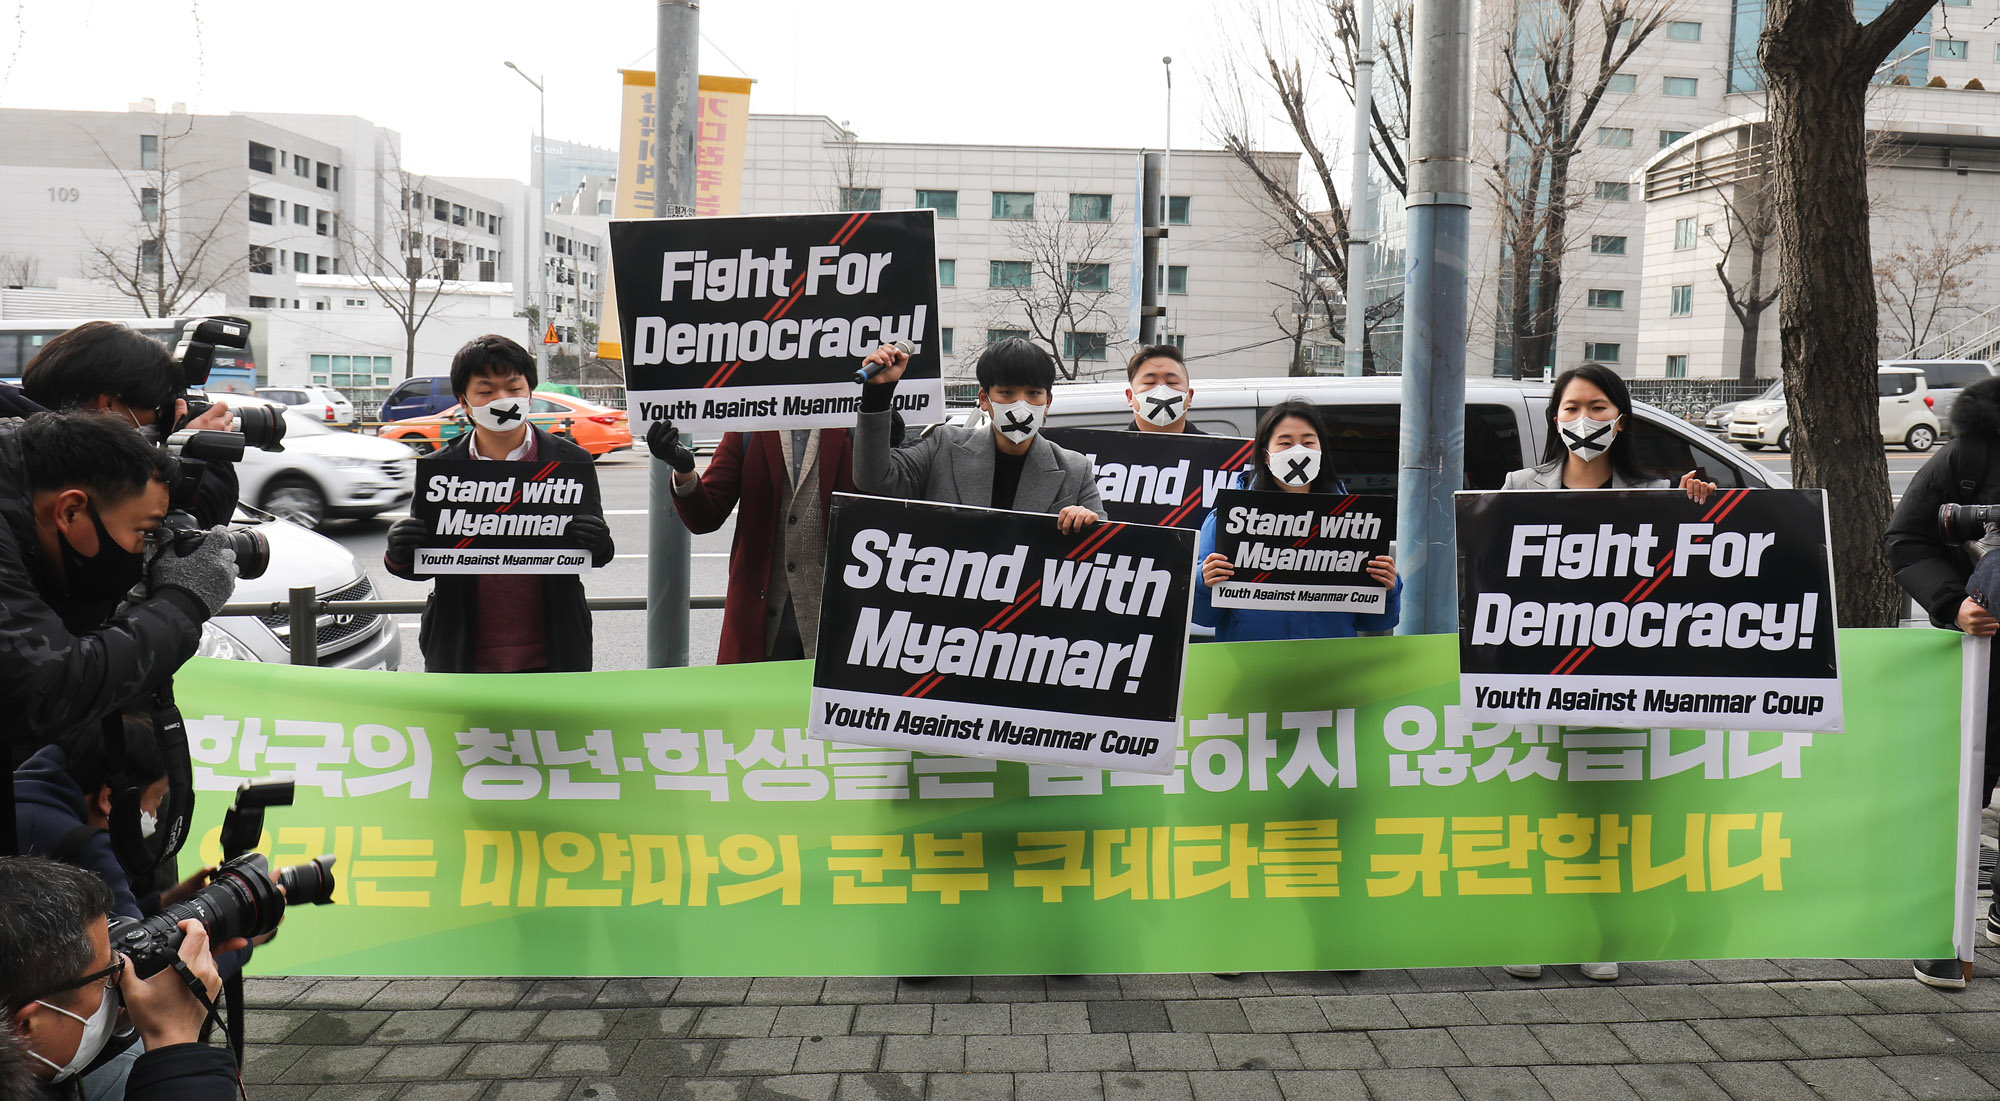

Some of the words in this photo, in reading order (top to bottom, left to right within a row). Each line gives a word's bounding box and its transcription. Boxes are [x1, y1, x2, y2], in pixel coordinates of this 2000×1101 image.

[47, 186, 80, 202] 109
[660, 247, 793, 302] Fight
[804, 245, 893, 297] For
[633, 304, 928, 366] Democracy!
[639, 400, 697, 421] Youth
[702, 398, 777, 419] Against
[782, 395, 863, 416] Myanma
[893, 393, 930, 411] oup
[426, 475, 516, 504] Stand
[522, 478, 584, 505] with
[1086, 453, 1191, 506] tand
[436, 508, 573, 537] Myanmar
[1225, 506, 1315, 538] Stand
[1319, 511, 1382, 540] with
[421, 554, 454, 566] Youth
[456, 554, 500, 567] Against
[502, 555, 555, 567] Myanmar
[557, 555, 585, 566] Coup
[843, 528, 1030, 604] Stand
[1040, 553, 1173, 618] with
[1234, 541, 1369, 573] Myanmar
[1506, 523, 1659, 580] Fight
[1672, 522, 1776, 578] For
[1218, 586, 1251, 600] Youth
[1252, 588, 1296, 602] Against
[1297, 590, 1349, 604] Myanmar
[1350, 591, 1380, 604] Coup
[1471, 592, 1819, 652] Democracy!
[846, 606, 1154, 695] Myanmar!
[1475, 686, 1541, 710] Youth
[1546, 687, 1637, 712] Against
[1643, 689, 1757, 714] Myanmar
[1762, 690, 1824, 716] Coup
[183, 714, 433, 800] 한국의
[1028, 708, 1358, 797] 하지
[823, 701, 890, 732] Youth
[893, 710, 984, 741] Against
[987, 719, 1097, 752] Myanmar
[1100, 730, 1160, 757] Coup
[460, 829, 801, 907] 미얀마의
[827, 832, 989, 905] 군부
[1013, 818, 1342, 903] 쿠데타를
[1366, 812, 1791, 897] 규탄합니다
